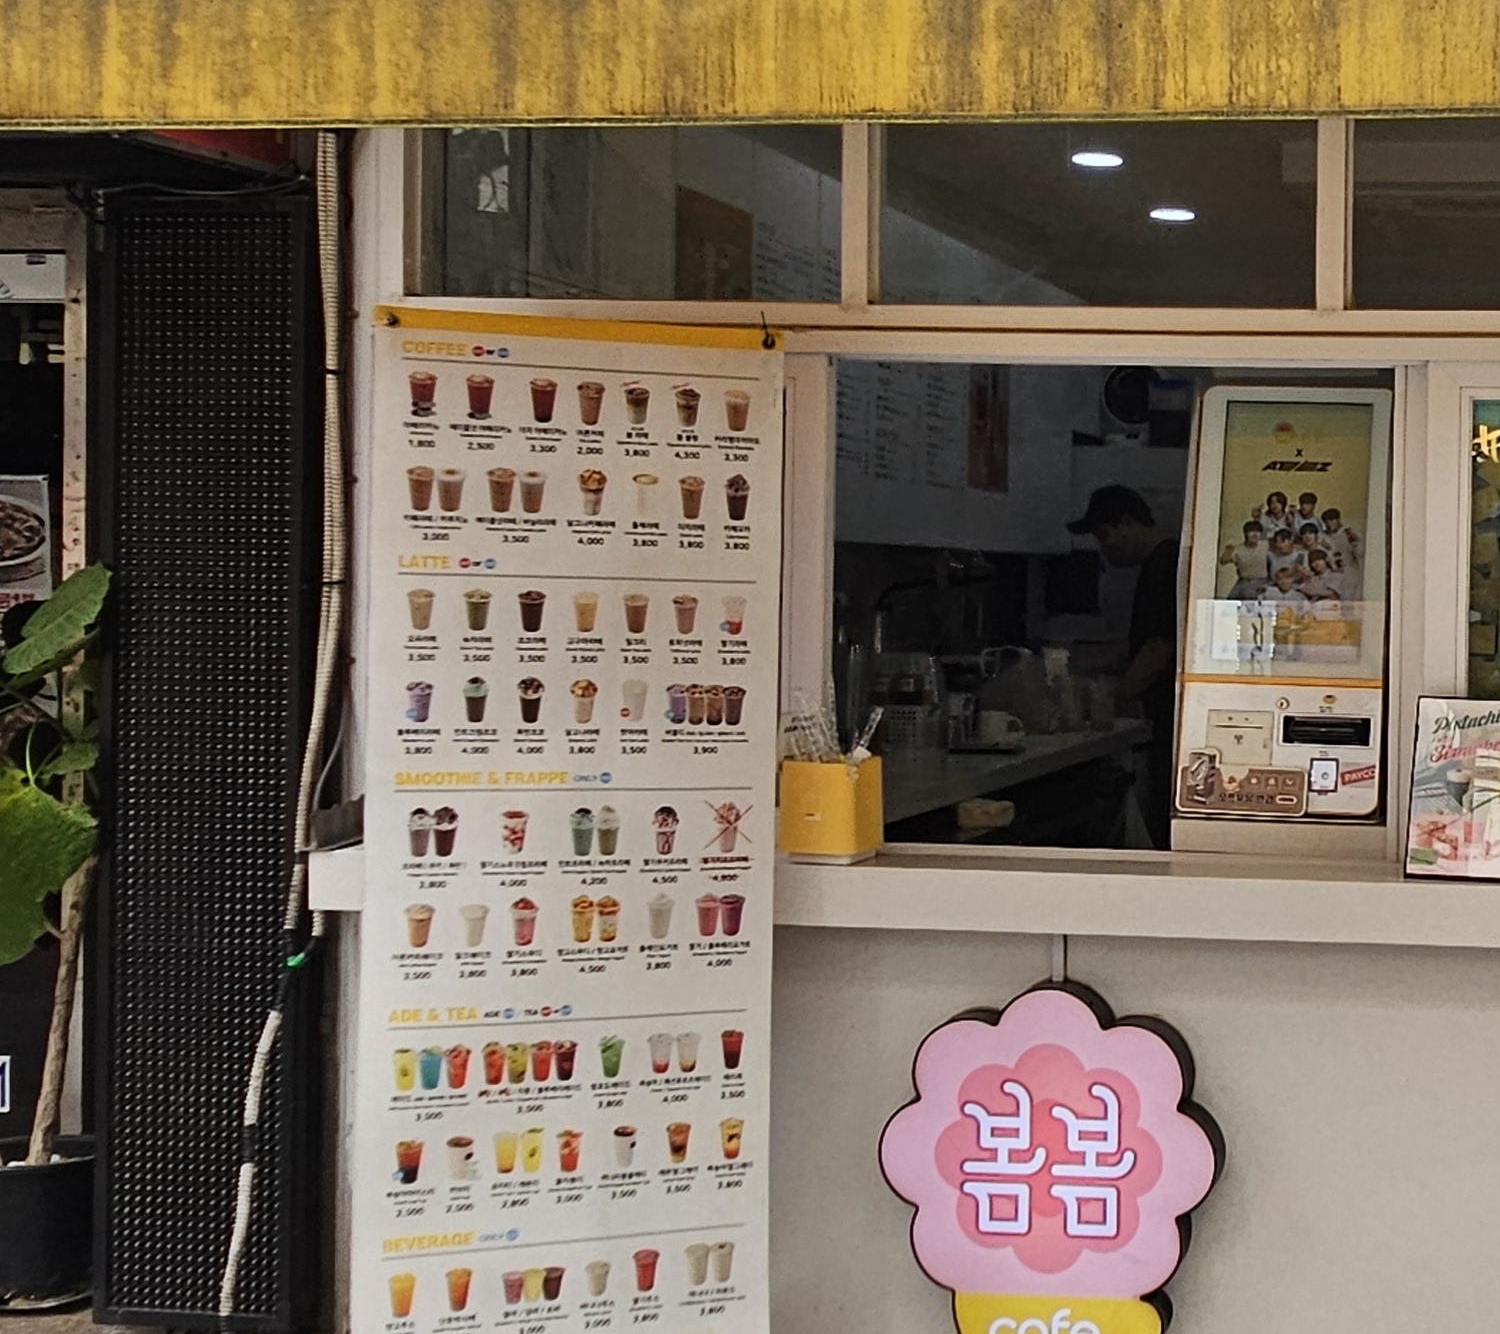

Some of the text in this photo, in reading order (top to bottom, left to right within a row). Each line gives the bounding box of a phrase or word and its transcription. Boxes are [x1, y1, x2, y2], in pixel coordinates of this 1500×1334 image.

[402, 340, 467, 356] COFFEE
[398, 555, 450, 569] LATTE
[504, 771, 569, 785] FRAPPE
[388, 1009, 422, 1023] ADE
[446, 1007, 479, 1021] TEA
[961, 1079, 1138, 1239] 봄봄
[382, 1230, 475, 1253] BEVERAGE
